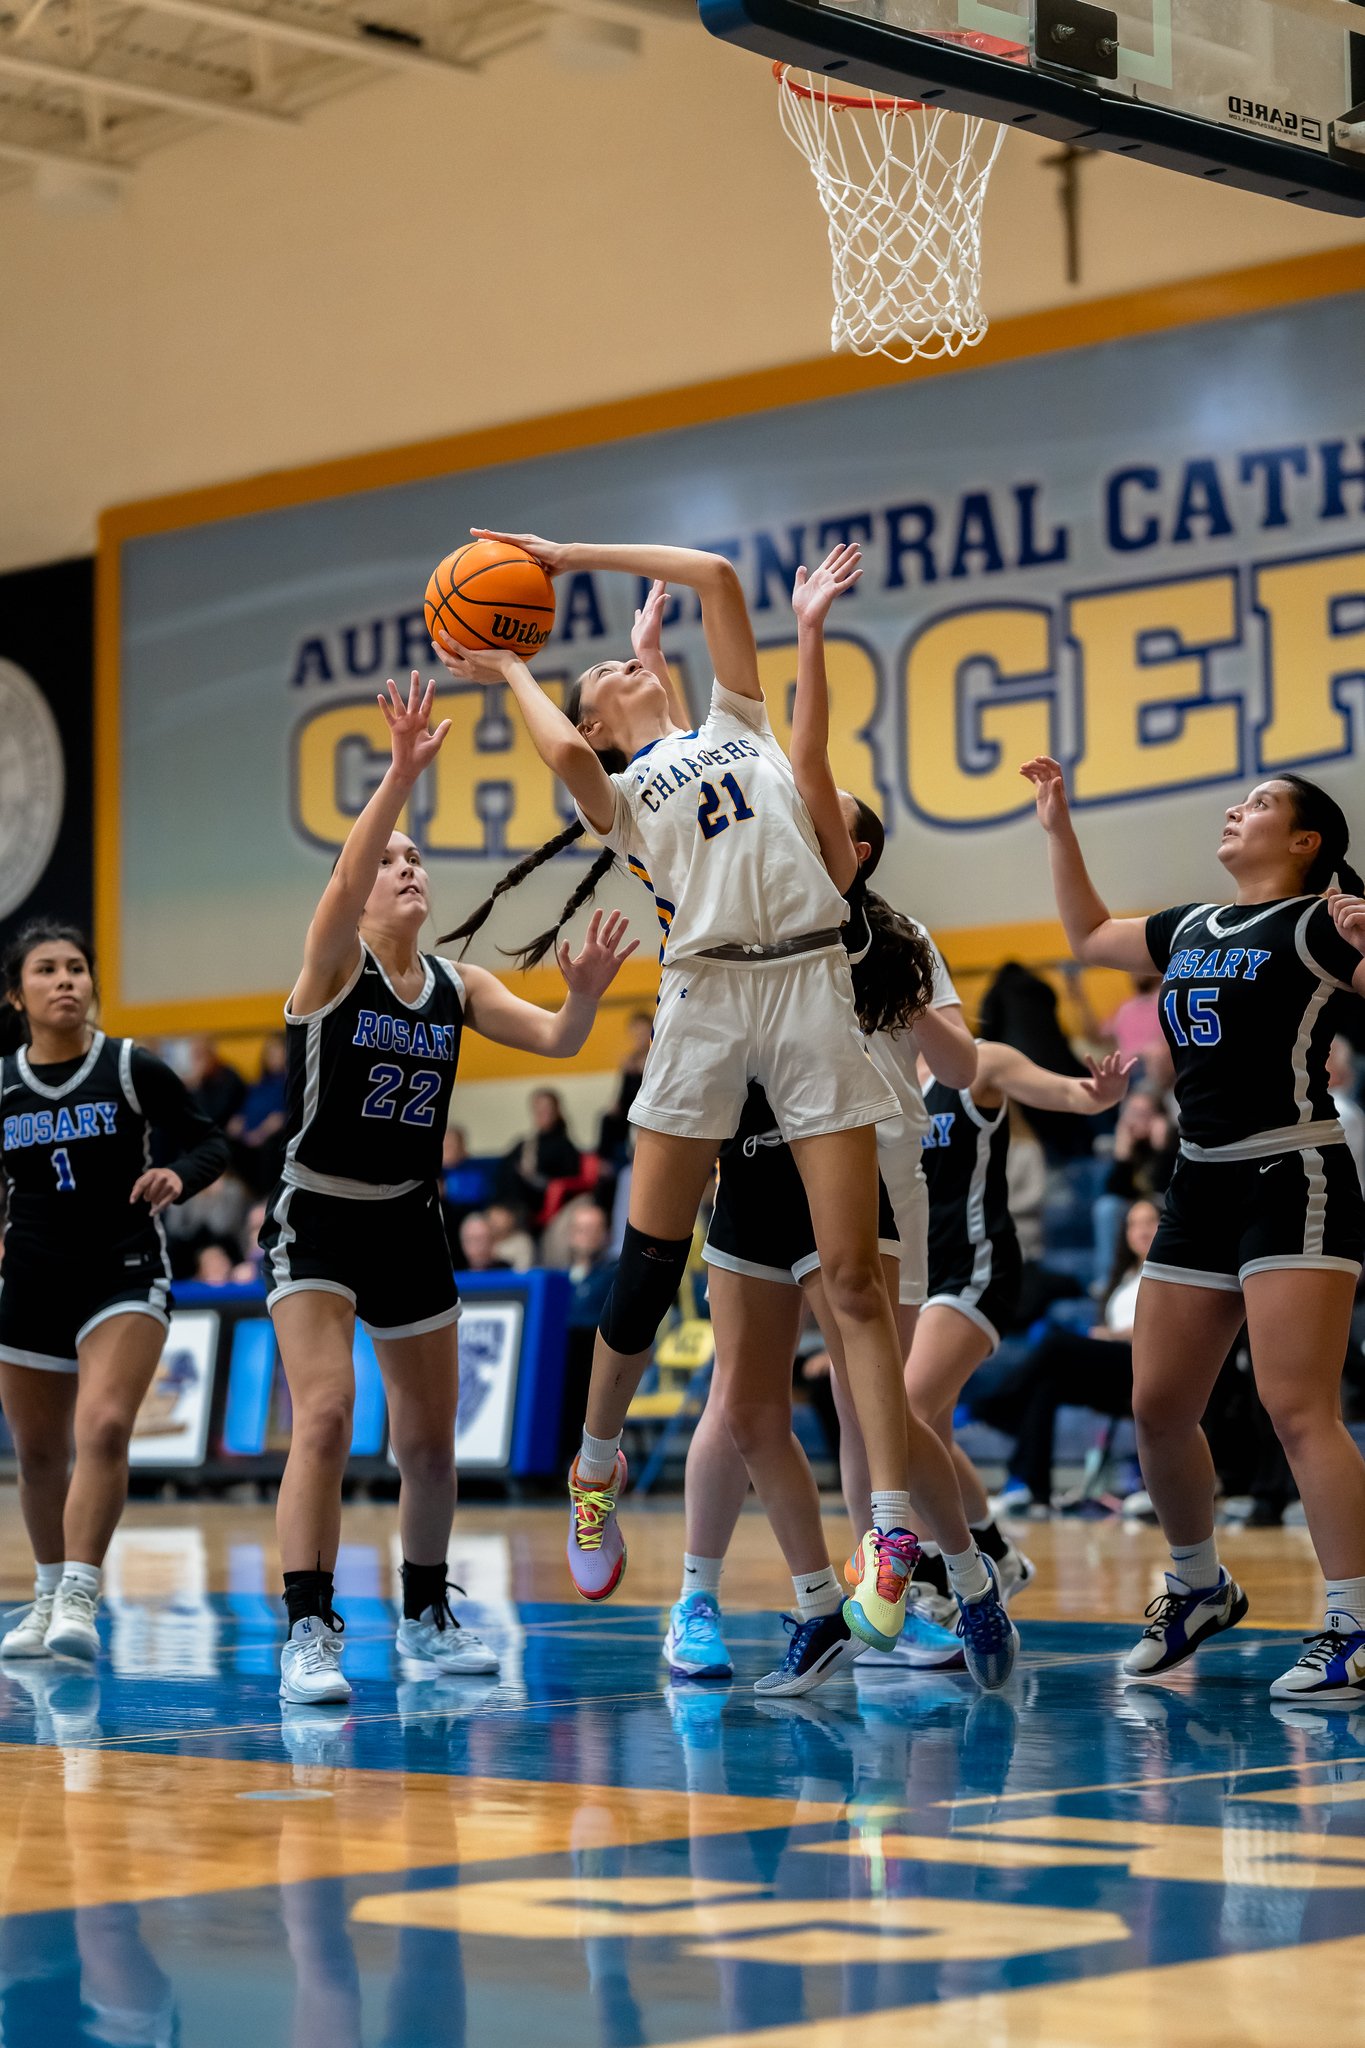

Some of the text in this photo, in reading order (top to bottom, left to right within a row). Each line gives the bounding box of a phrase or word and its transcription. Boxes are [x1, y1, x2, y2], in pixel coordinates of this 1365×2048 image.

[291, 569, 606, 688] AURA
[698, 771, 756, 841] 21
[1164, 987, 1222, 1047] 15
[3, 1101, 118, 1151] ROSARY
[361, 1063, 442, 1127] 22
[51, 1148, 76, 1192] 1
